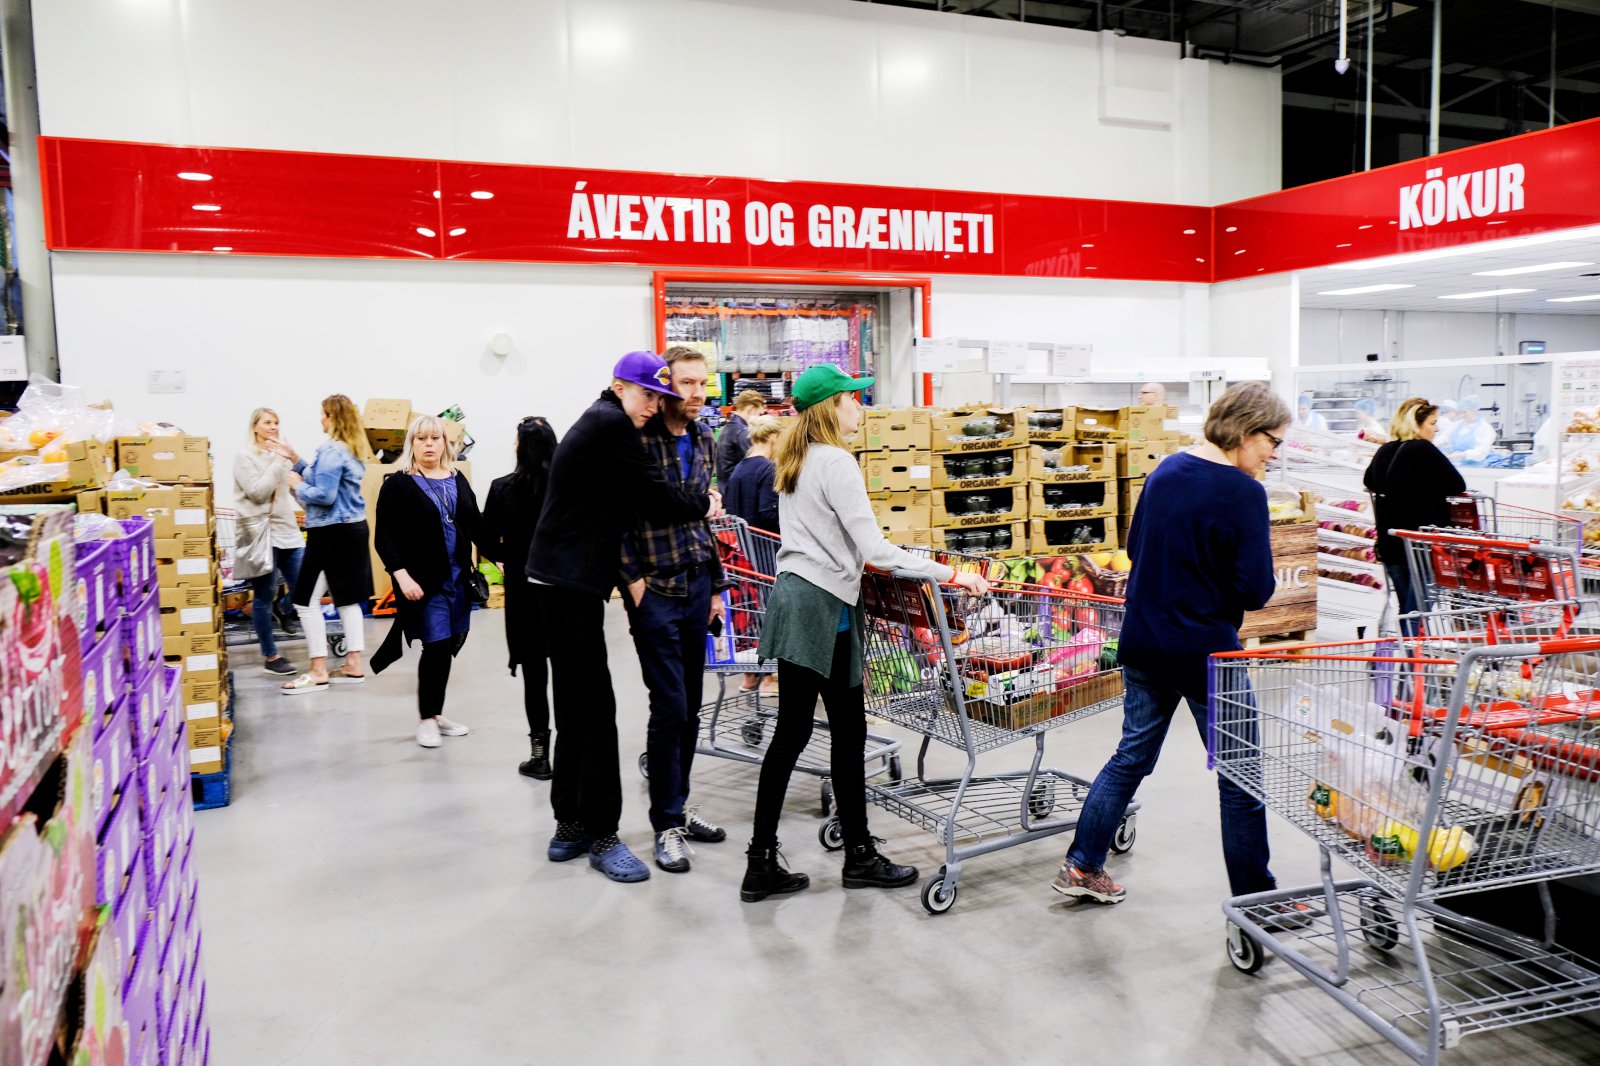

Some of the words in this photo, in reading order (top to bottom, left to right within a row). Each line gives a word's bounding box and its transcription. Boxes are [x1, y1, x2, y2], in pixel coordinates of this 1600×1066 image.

[1399, 163, 1526, 231] KÖKUR
[566, 181, 732, 244] ÁVEXTIR
[745, 201, 796, 246] OG
[808, 204, 994, 254] GRÆNMETI
[961, 440, 1002, 452] ORGANIC
[1055, 472, 1092, 481] ORGANIC
[960, 478, 1001, 489] ORGANIC
[1056, 508, 1093, 518] ORGANIC
[961, 515, 1001, 526] ORGANIC
[1057, 545, 1095, 555] ORGANIC
